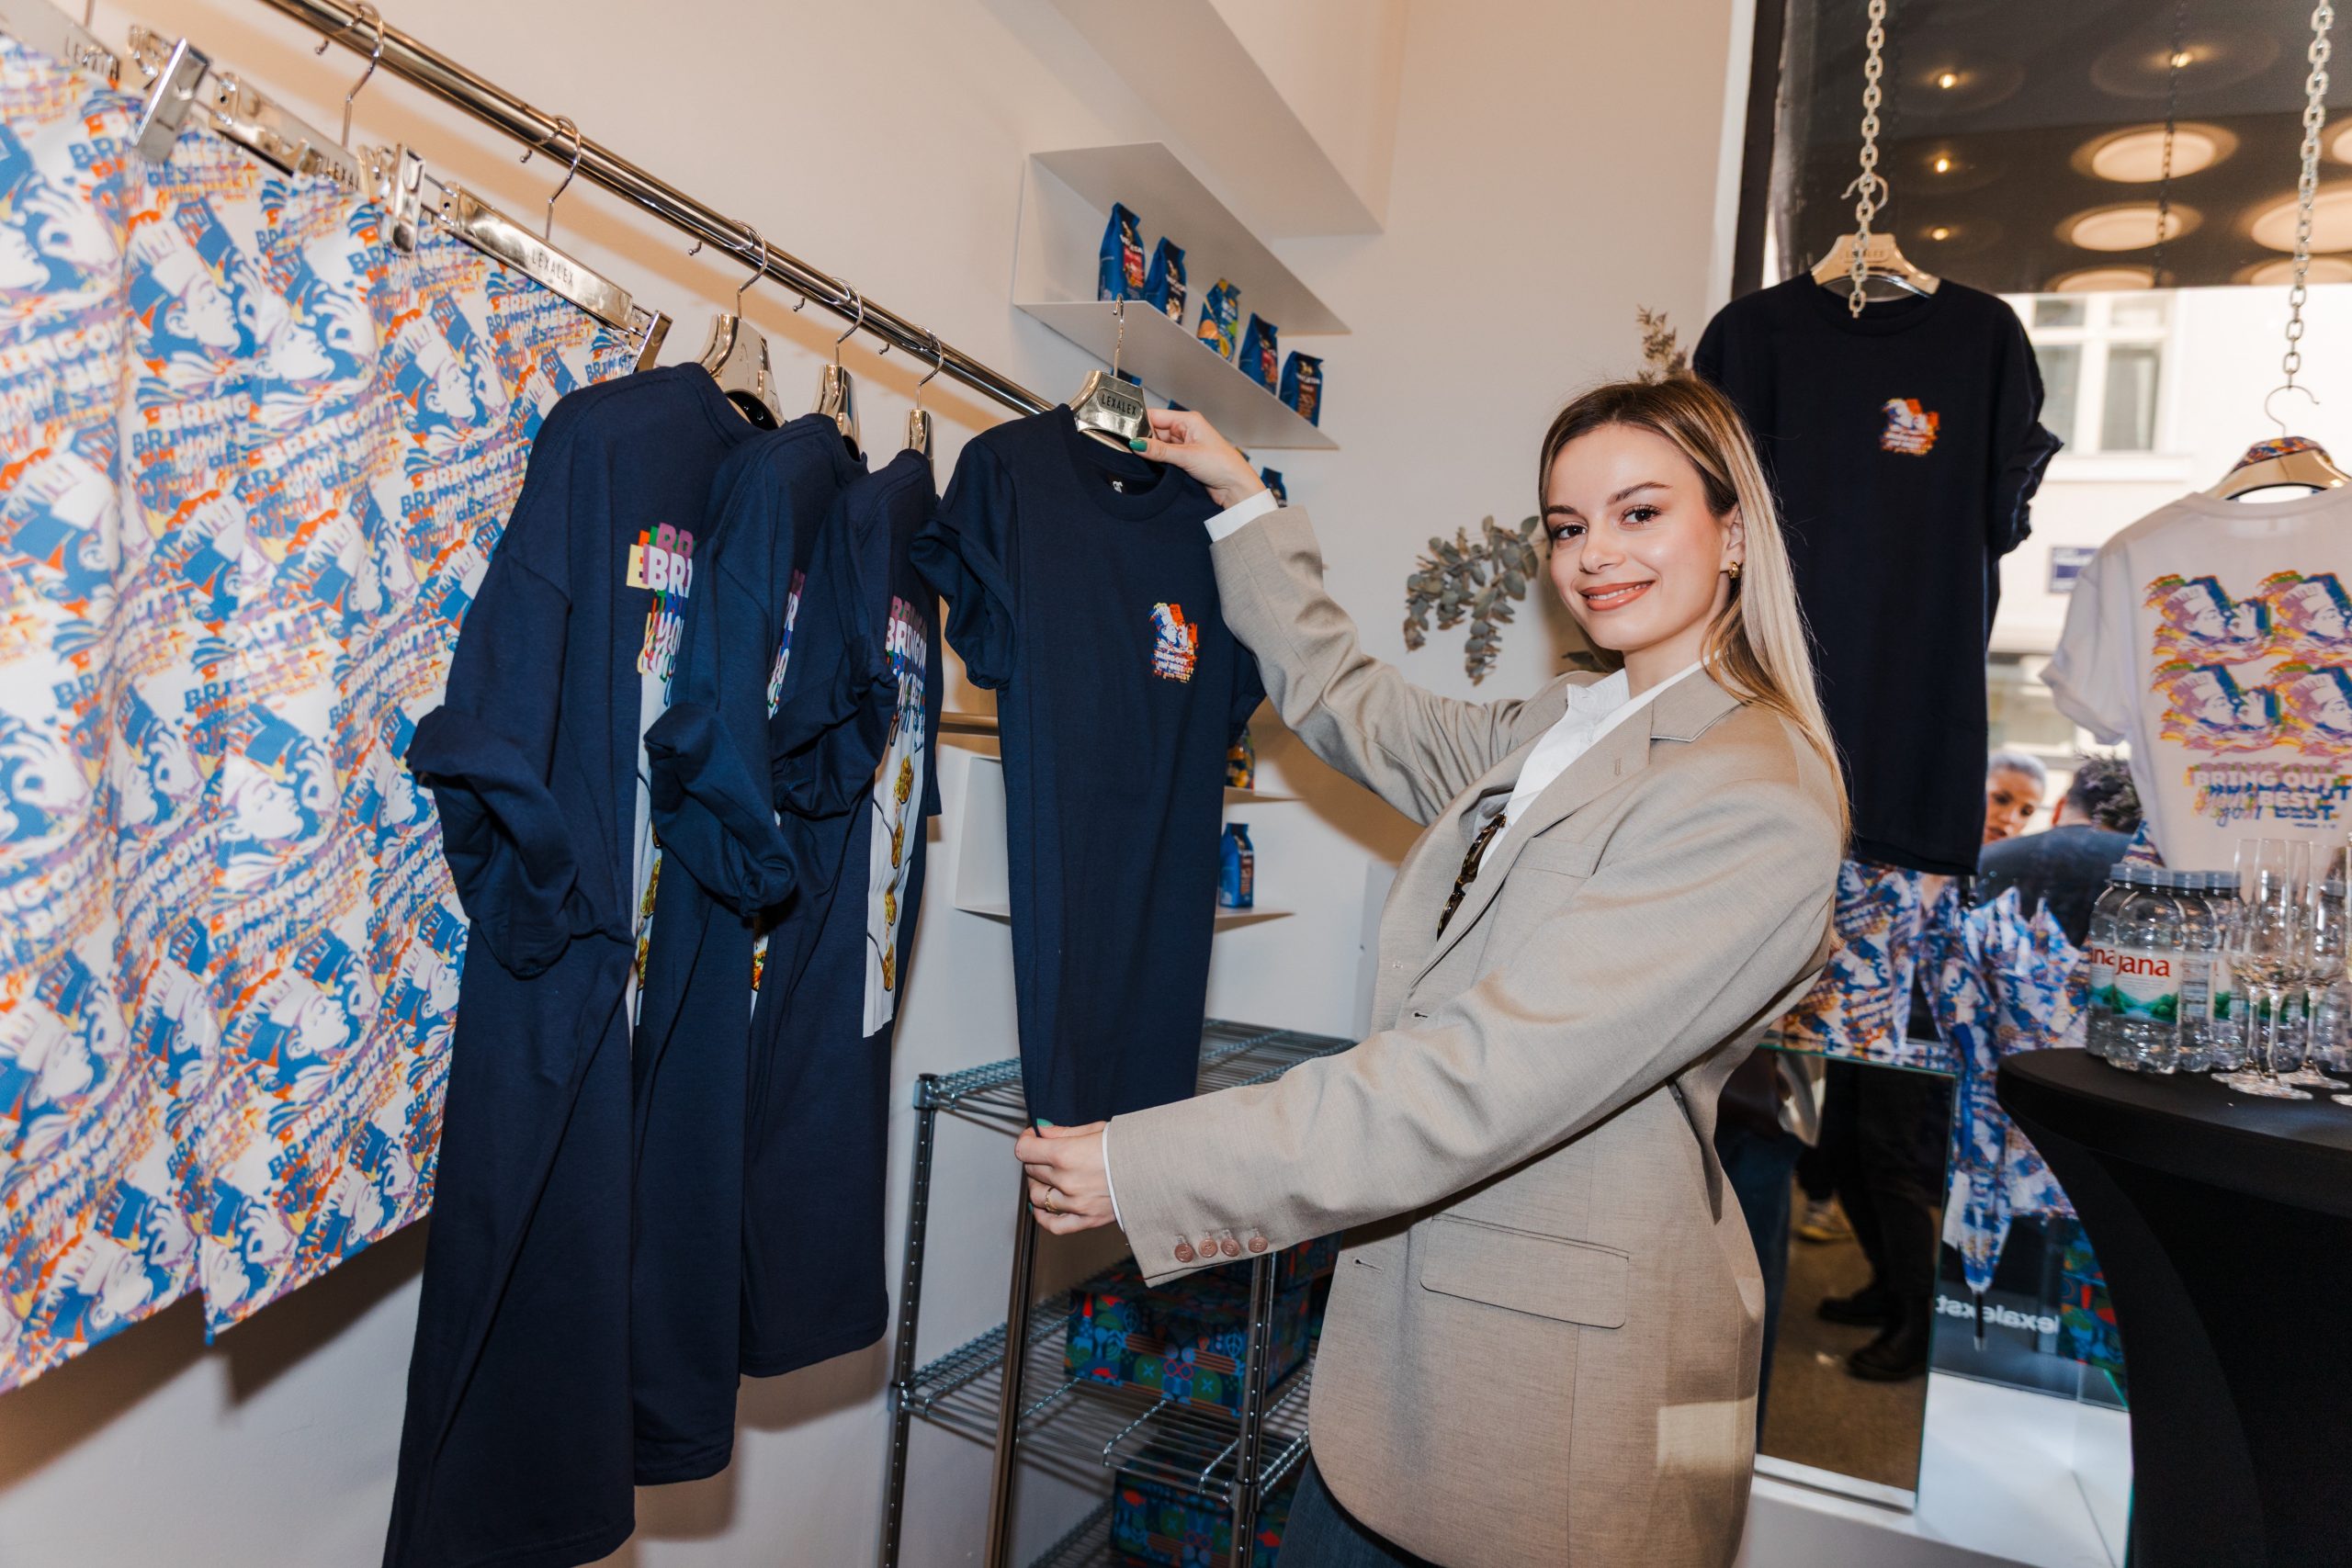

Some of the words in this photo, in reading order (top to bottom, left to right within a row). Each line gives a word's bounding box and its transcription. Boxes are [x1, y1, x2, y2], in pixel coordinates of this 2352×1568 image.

[532, 249, 573, 287] LEXALEX
[1102, 393, 1136, 416] LEXALEX
[2192, 770, 2280, 791] BRING
[2282, 771, 2342, 793] OUT
[2115, 955, 2170, 977] jana
